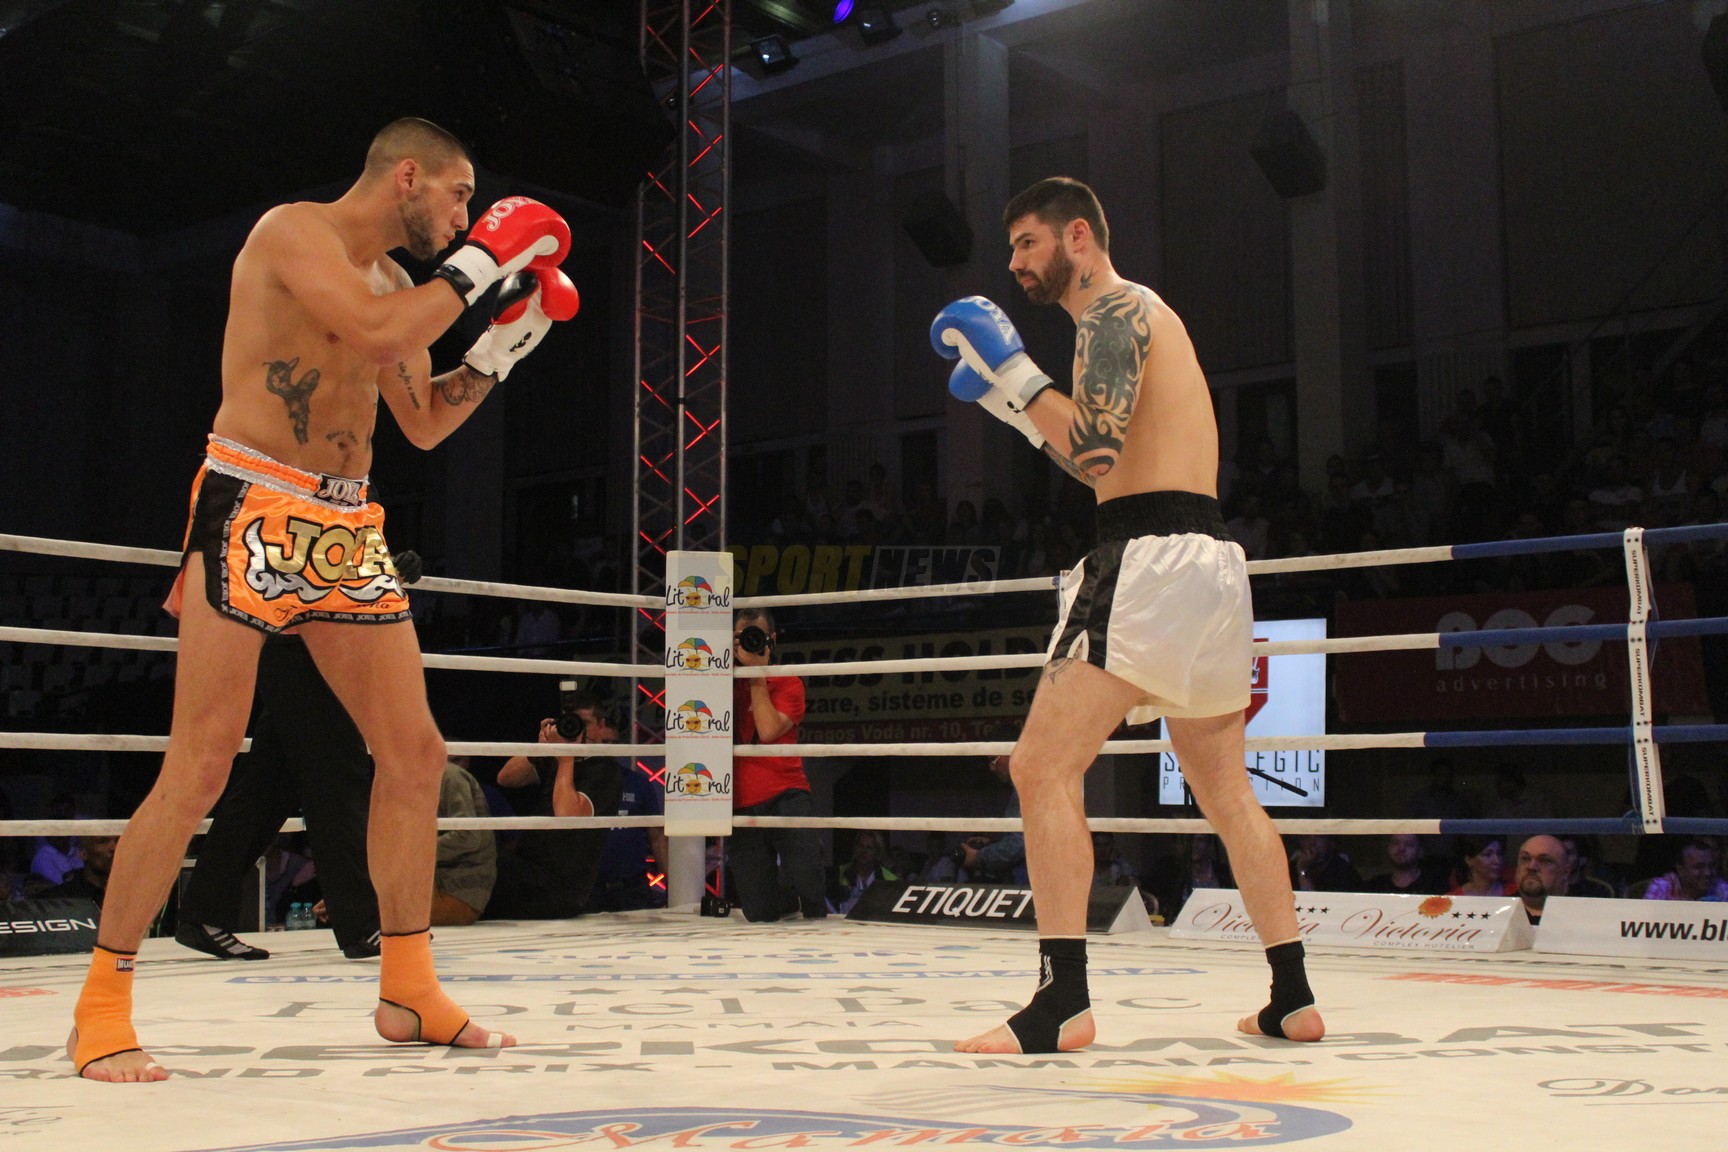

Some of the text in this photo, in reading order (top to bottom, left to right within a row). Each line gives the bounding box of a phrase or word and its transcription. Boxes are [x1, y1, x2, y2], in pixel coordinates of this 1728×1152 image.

[902, 635, 1050, 684] HOLD
[1436, 673, 1607, 692] advertising
[868, 689, 964, 712] sisteme
[972, 686, 1003, 707] de
[891, 885, 1038, 918] ETIQUET
[1341, 907, 1482, 941] Victoria
[1620, 919, 1728, 941] www.bl
[564, 1020, 923, 1031] MAMAIA
[362, 1062, 657, 1077] PRIX
[1337, 1042, 1728, 1061] CONST
